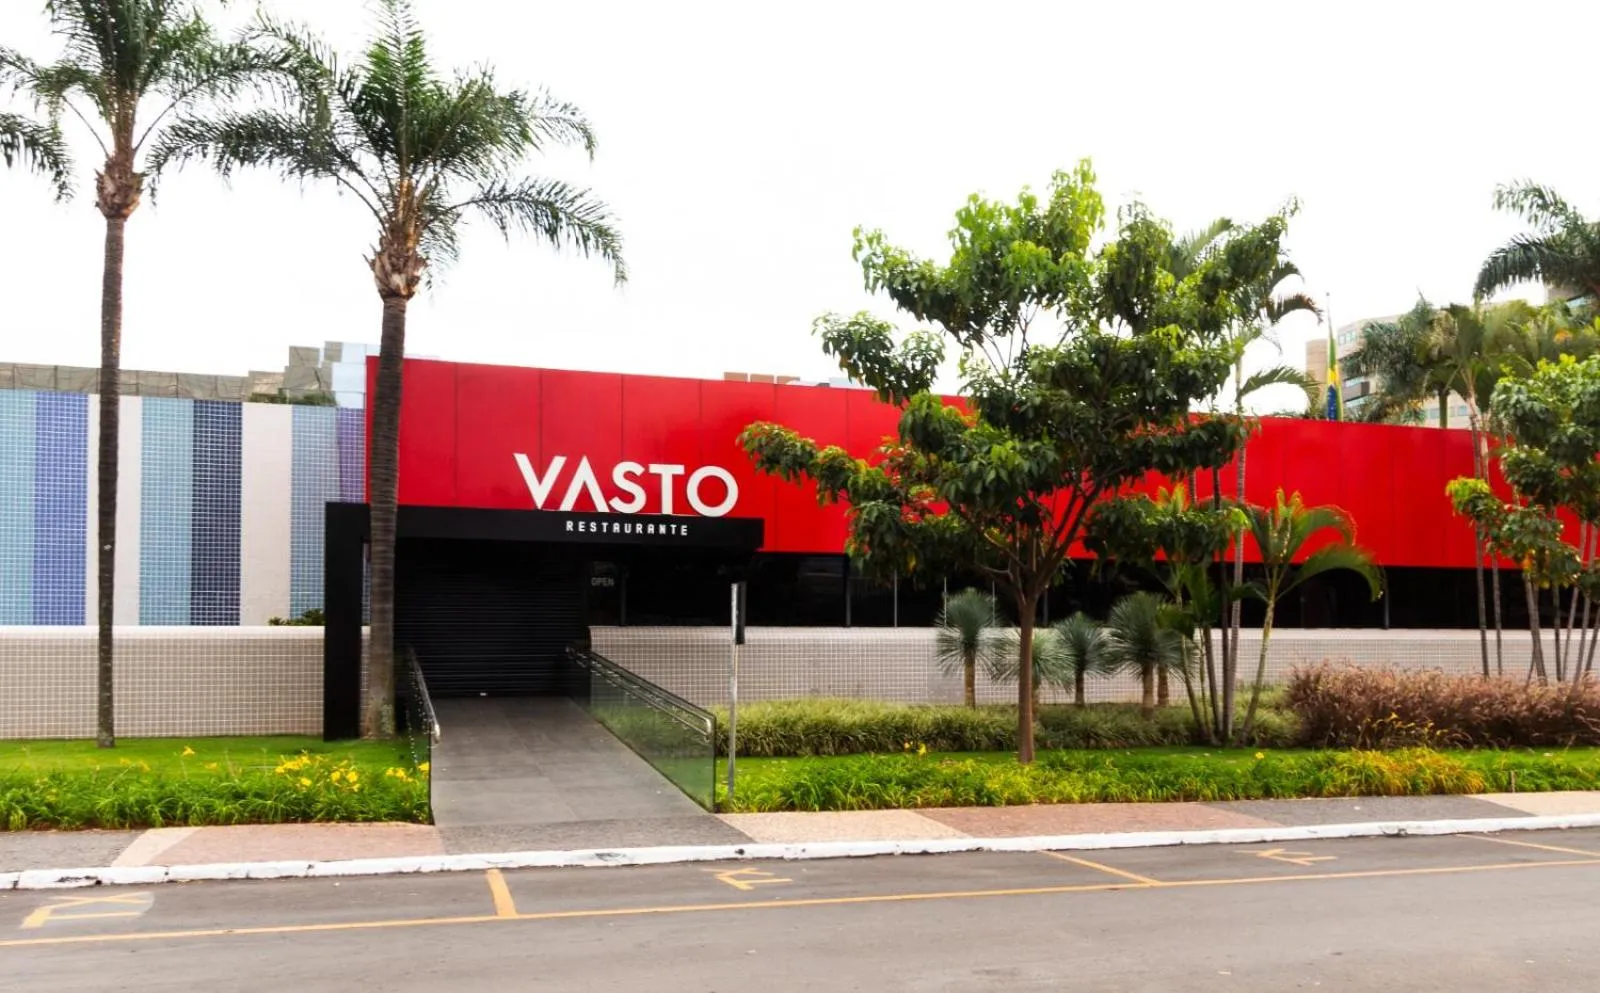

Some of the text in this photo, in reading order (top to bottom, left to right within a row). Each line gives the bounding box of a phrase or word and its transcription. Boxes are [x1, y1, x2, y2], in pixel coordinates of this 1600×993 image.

[513, 453, 739, 517] VASTO
[566, 520, 688, 536] RESTAURANTE
[591, 577, 614, 586] OPEN
